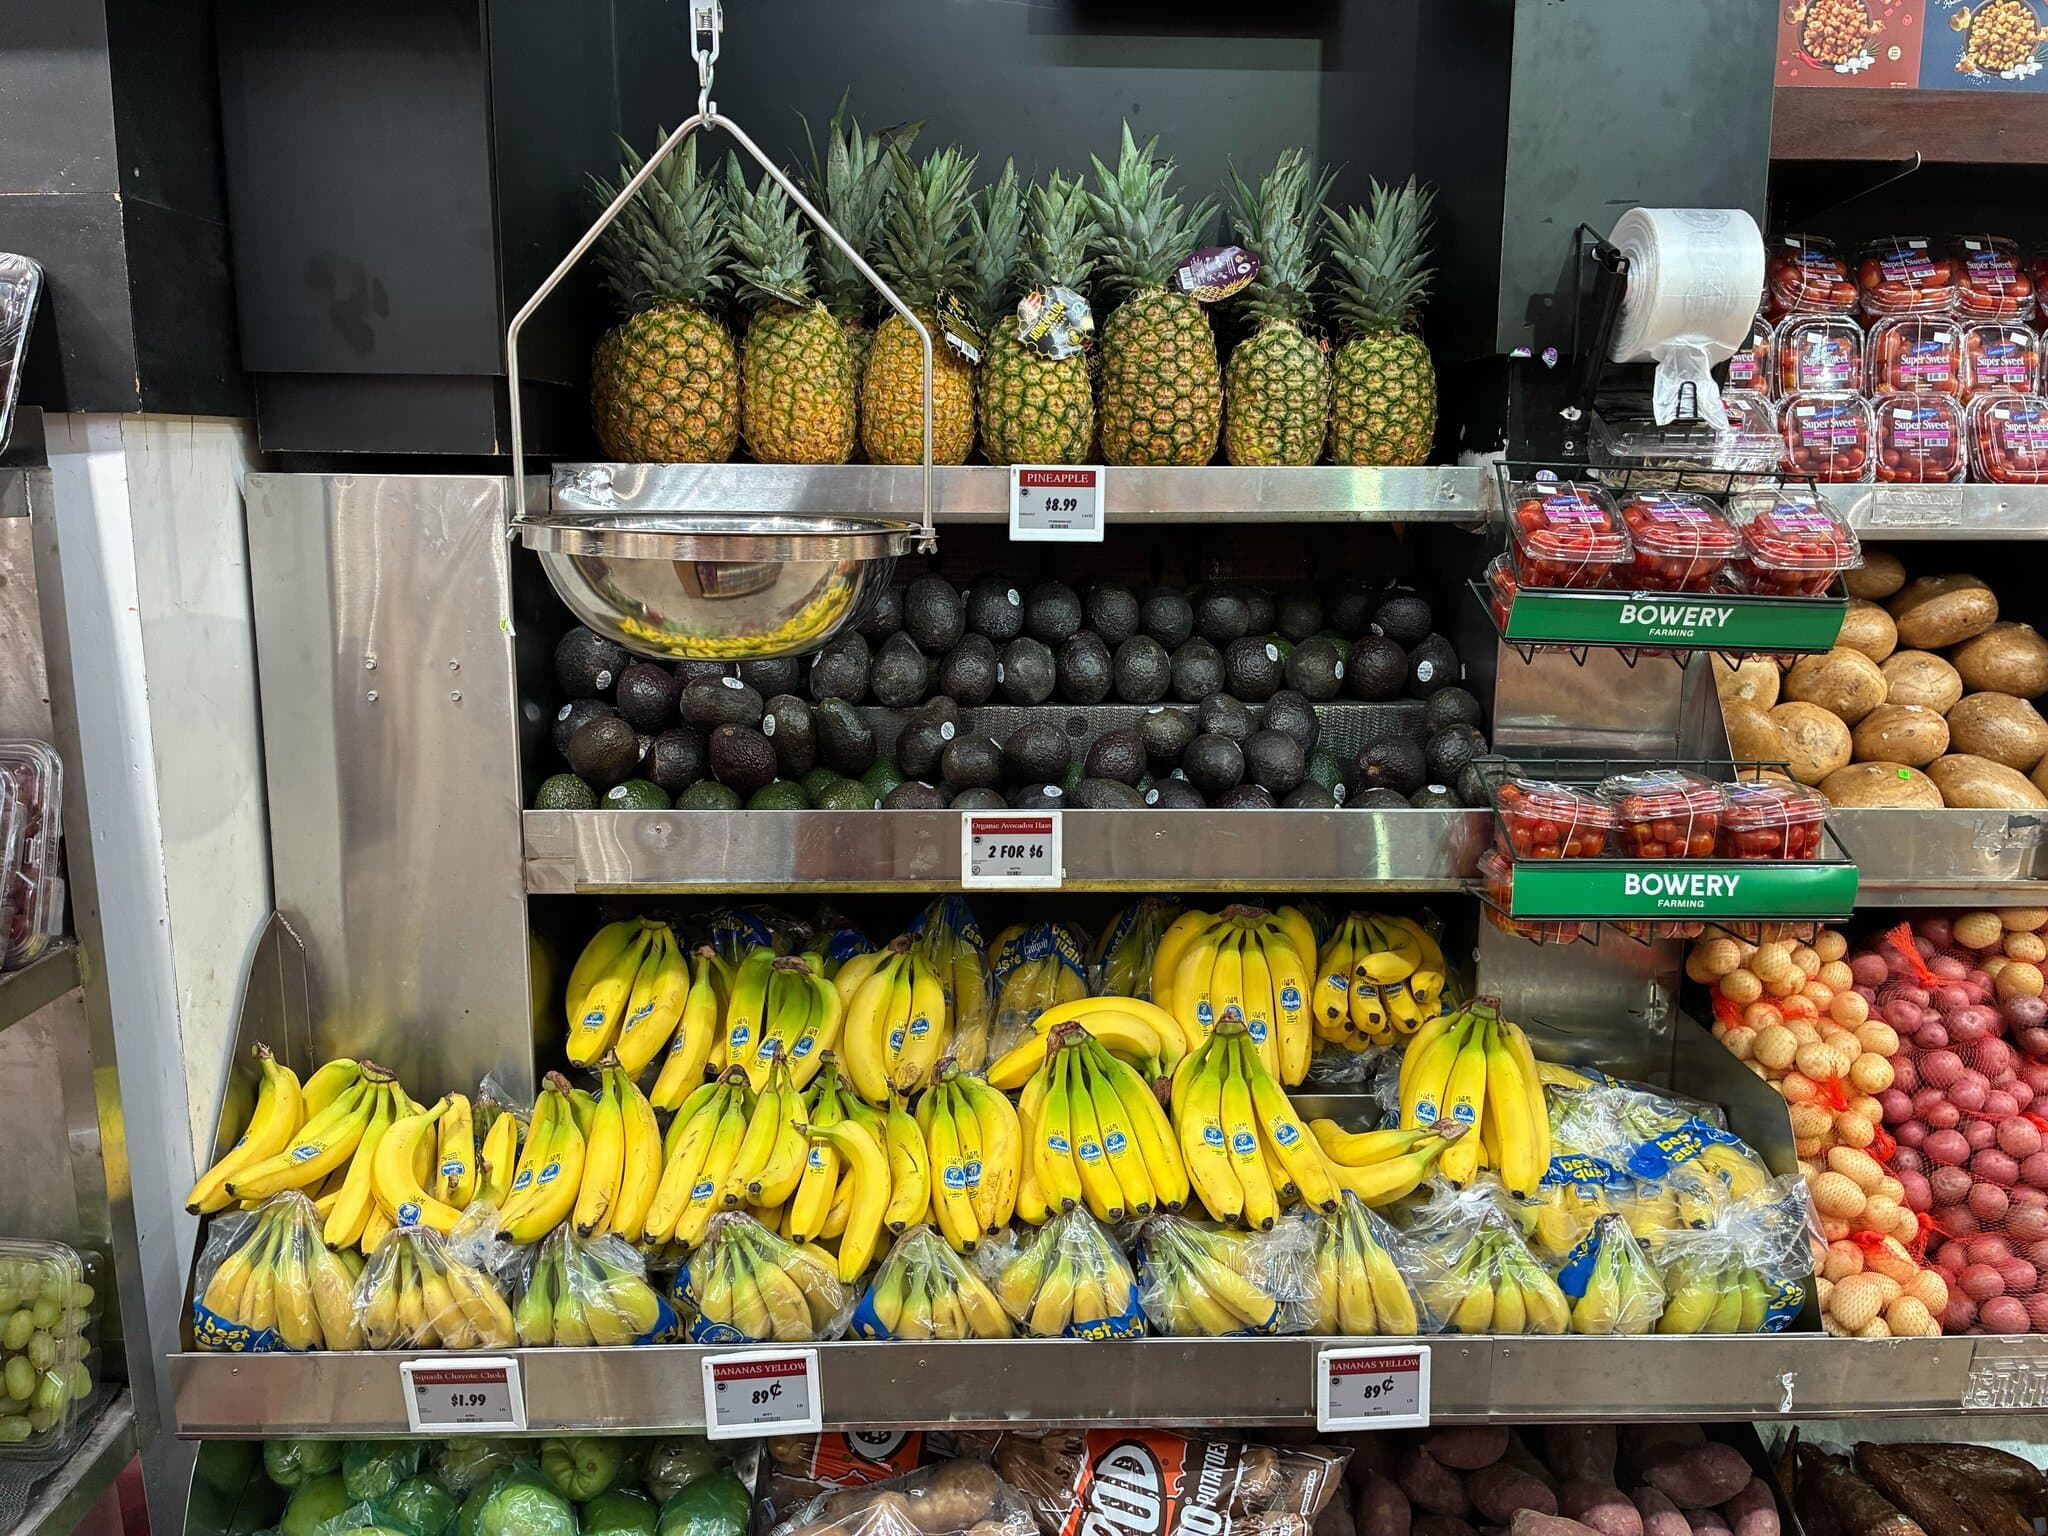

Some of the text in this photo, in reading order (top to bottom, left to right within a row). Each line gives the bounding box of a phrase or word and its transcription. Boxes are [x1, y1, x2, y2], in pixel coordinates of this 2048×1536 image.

[1901, 354, 1950, 365] Super Sweet
[1977, 356, 2024, 367] Super Sweet
[1802, 418, 1856, 430] Super Sweet
[1894, 420, 1949, 432] Super Sweet
[2005, 422, 2028, 433] Super
[1027, 473, 1089, 484] PINEAPPLE
[1045, 497, 1077, 512] $8.99
[1619, 605, 1735, 629] BOWERY
[1648, 628, 1695, 638] FARMING
[972, 822, 999, 831] Organic
[1001, 822, 1033, 830] Avocados
[988, 844, 1043, 859] 2 FOR $6
[1624, 873, 1740, 897] BOWERY
[1657, 899, 1705, 909] FARMING
[205, 1316, 250, 1340] best
[714, 1362, 806, 1377] BANANAS YELLOW
[1330, 1359, 1419, 1371] BANANAS YELLOW
[451, 1393, 486, 1408] $1.99
[1195, 1440, 1229, 1507] POTATOES
